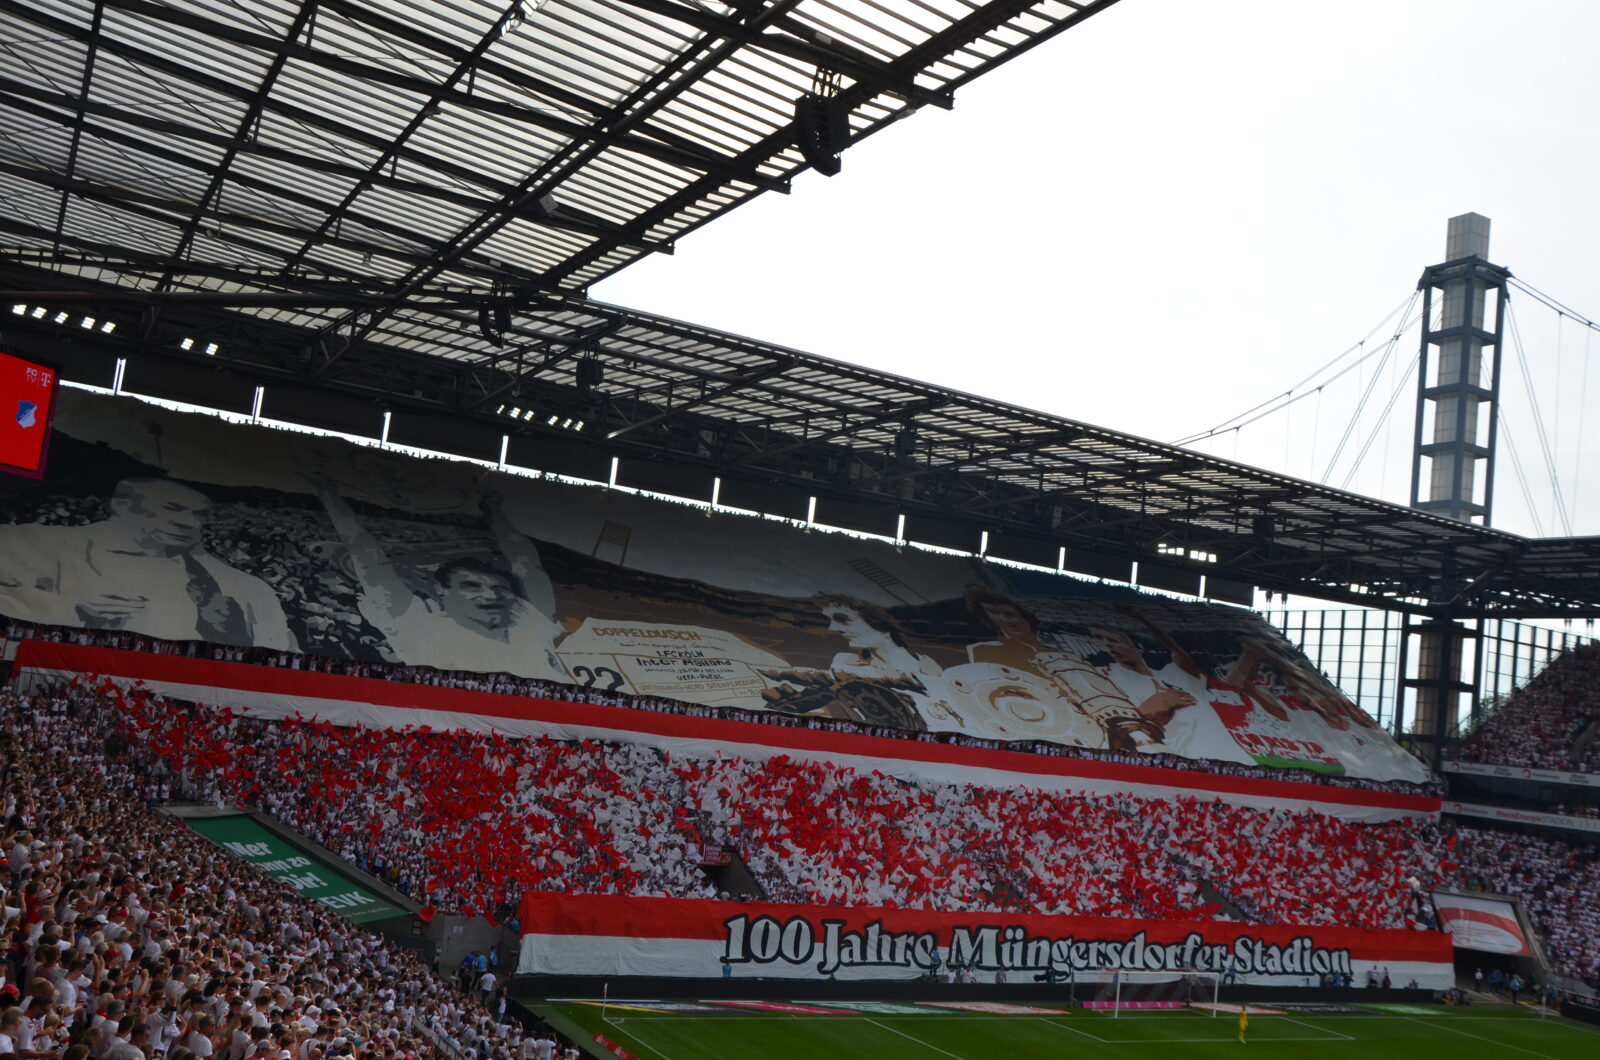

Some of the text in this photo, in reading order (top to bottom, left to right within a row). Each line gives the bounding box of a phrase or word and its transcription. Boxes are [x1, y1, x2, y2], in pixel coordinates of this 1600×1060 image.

[222, 841, 273, 857] Mer
[720, 913, 815, 964] 100
[817, 919, 942, 975] Jahre
[1231, 935, 1353, 976] Stadion
